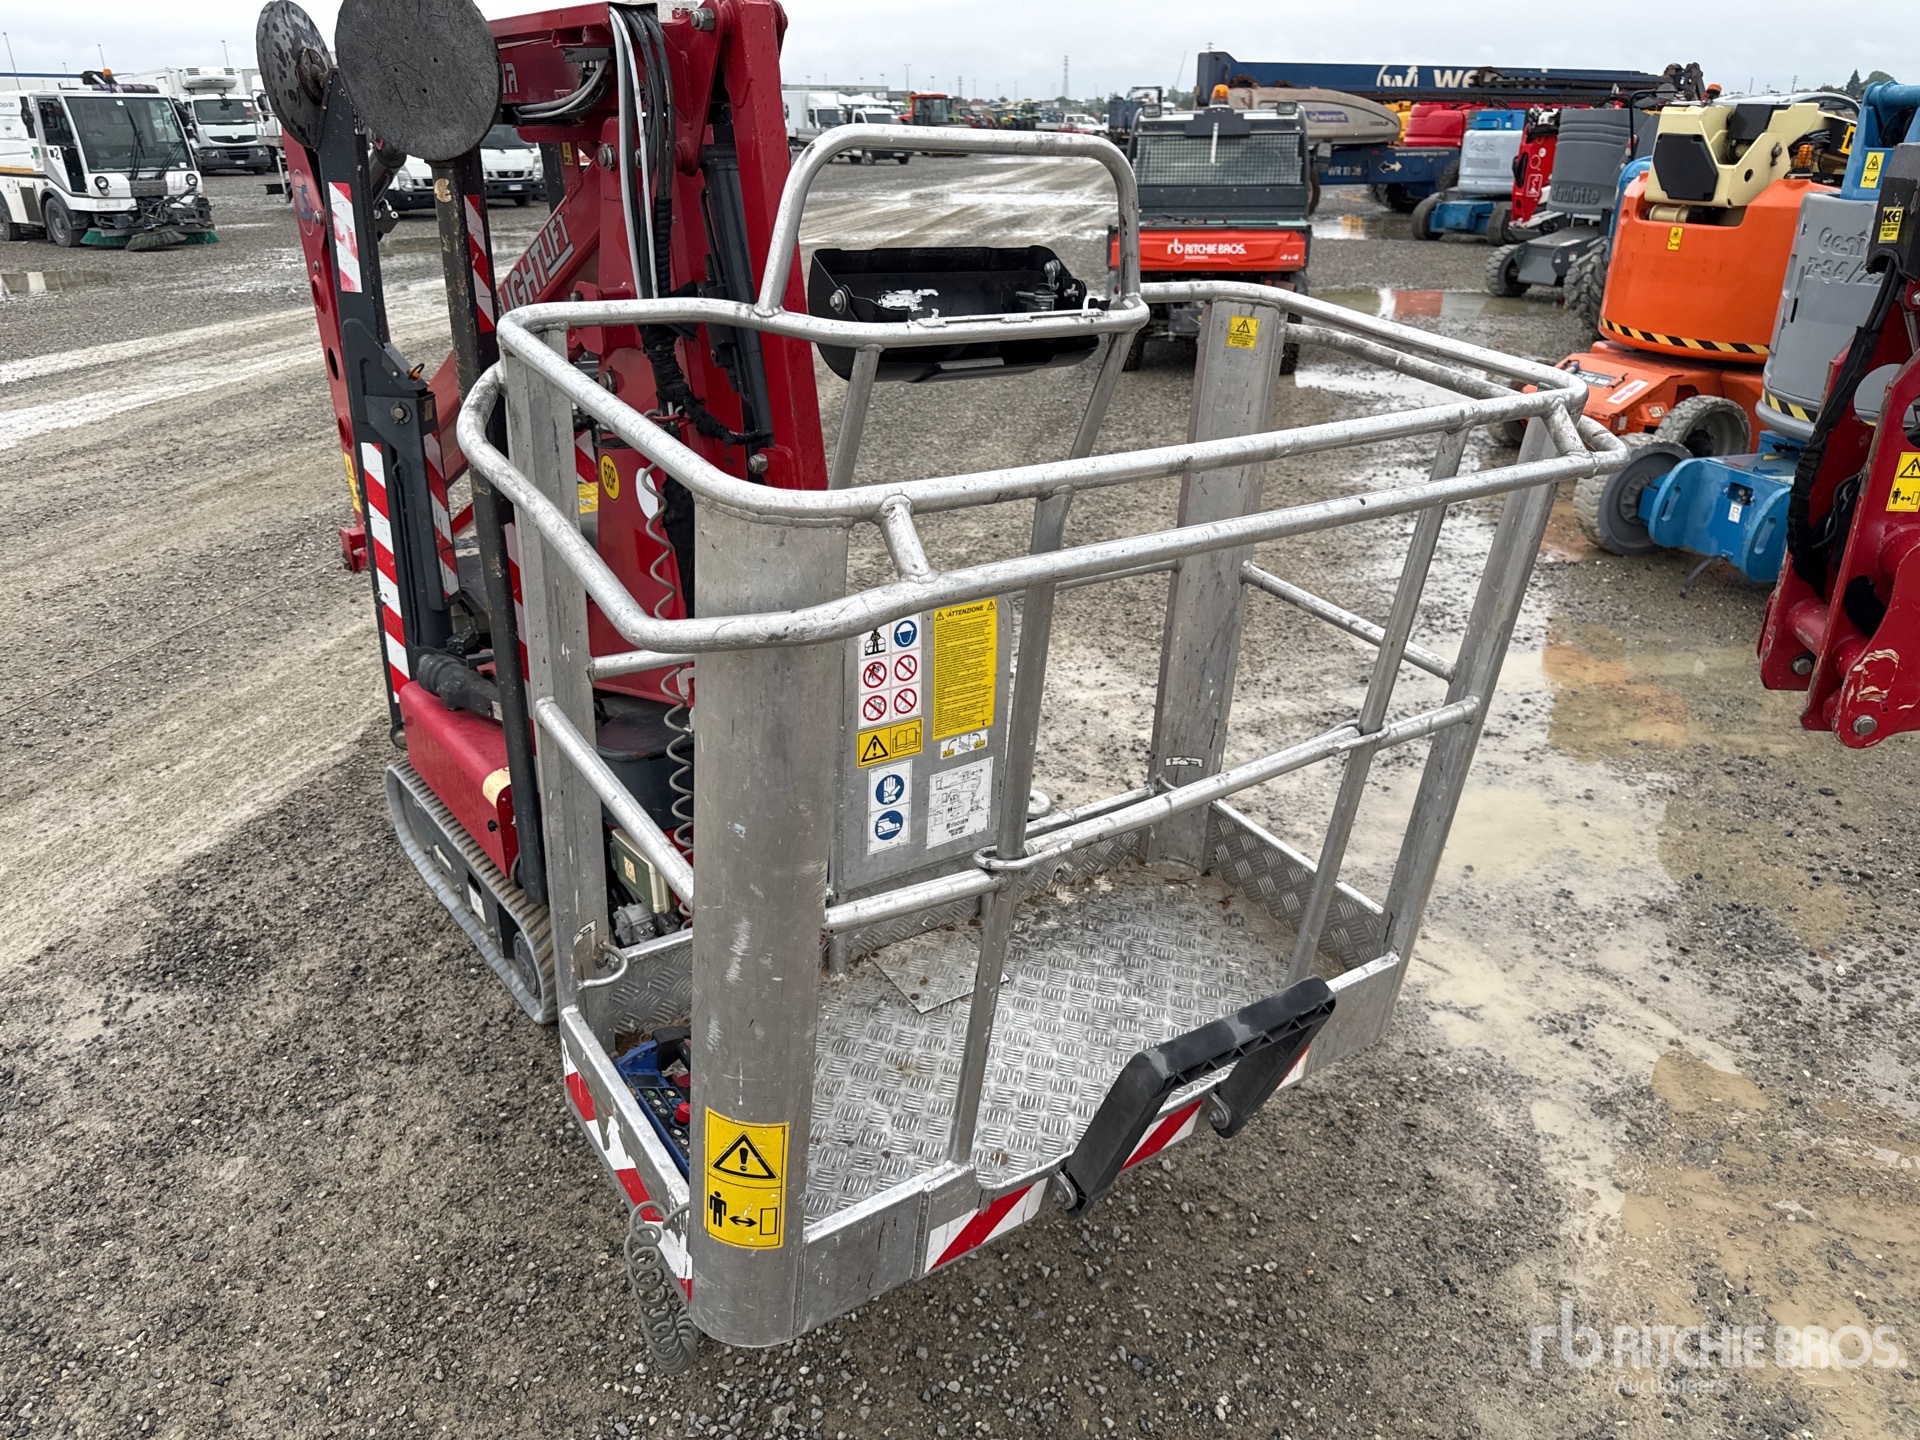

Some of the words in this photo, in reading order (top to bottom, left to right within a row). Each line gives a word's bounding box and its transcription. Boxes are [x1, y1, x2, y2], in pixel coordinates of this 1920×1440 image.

[1552, 184, 1600, 205] Haulotte
[1184, 244, 1217, 254] RITCHIE
[1218, 244, 1247, 254] BROS.
[947, 604, 985, 618] ATTENZIONE
